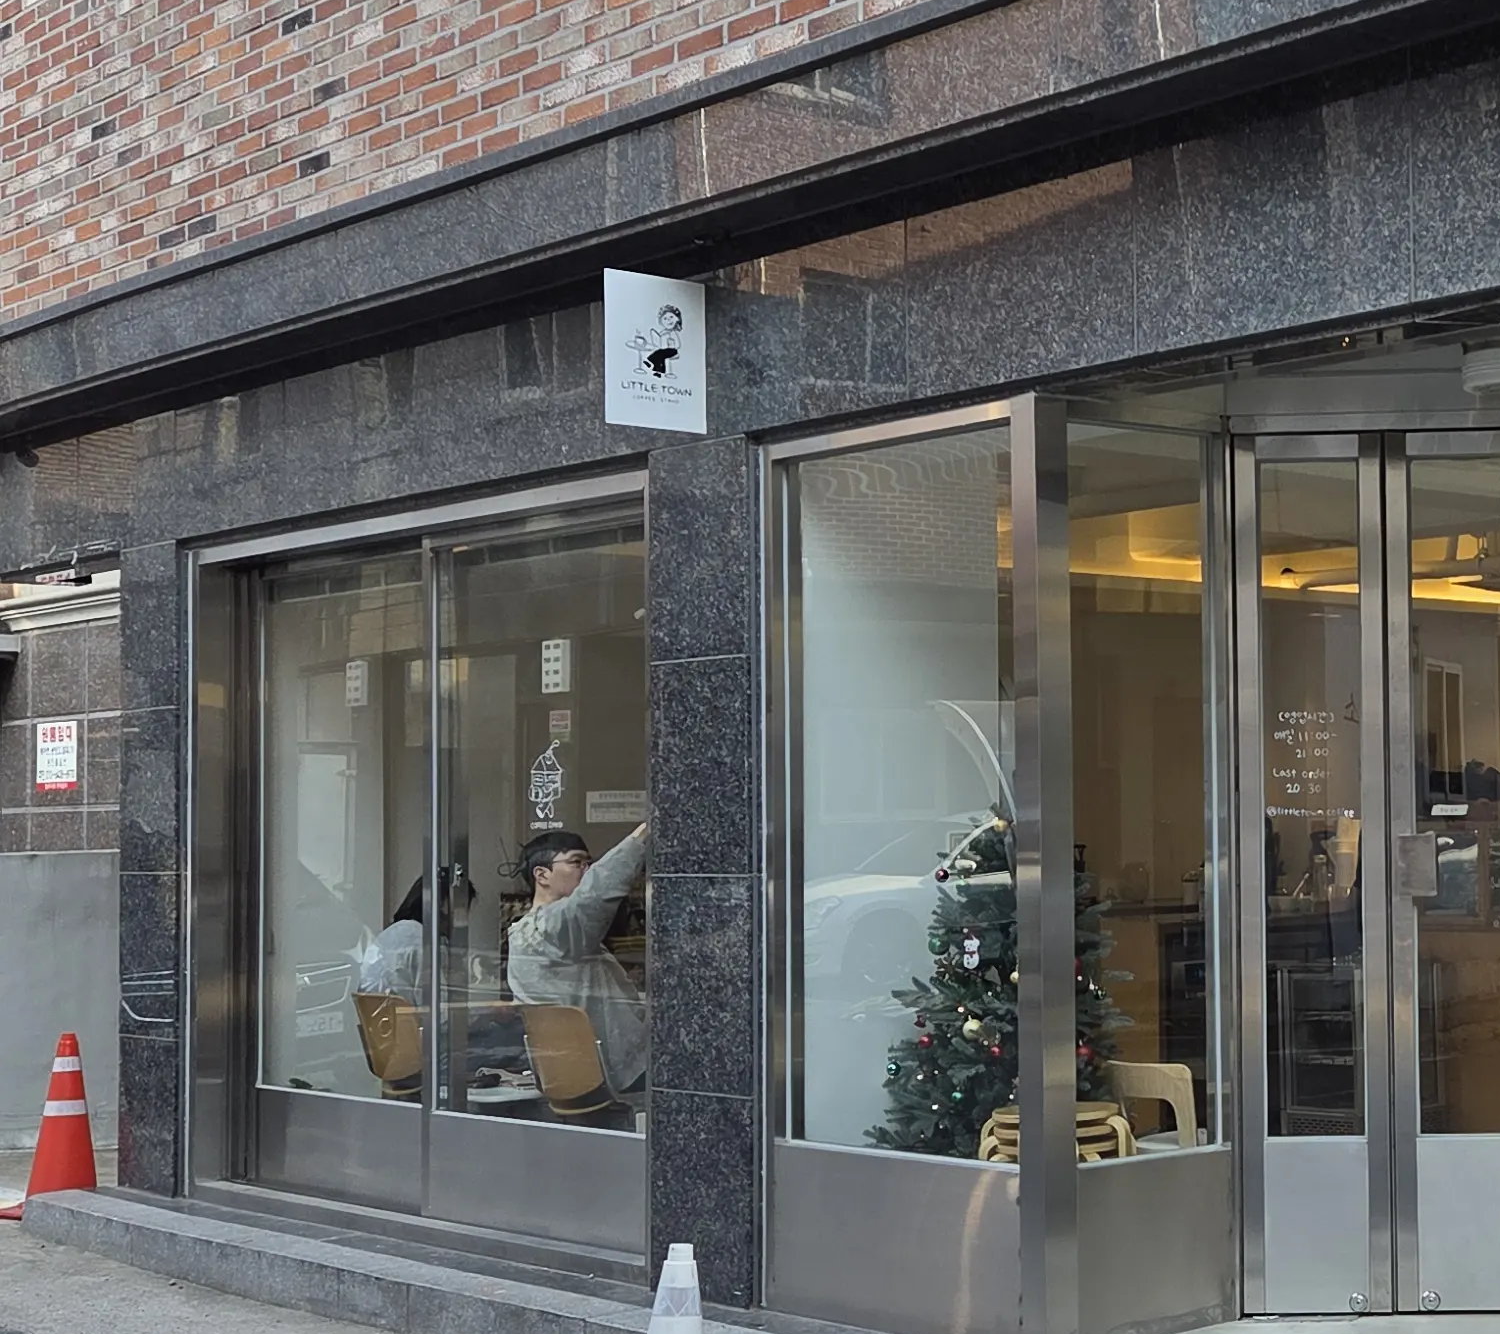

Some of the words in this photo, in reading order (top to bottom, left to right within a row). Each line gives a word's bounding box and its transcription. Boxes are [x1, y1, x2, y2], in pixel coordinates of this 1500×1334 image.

[621, 380, 658, 394] LITTLE
[660, 385, 692, 397] TOWN
[1272, 768, 1297, 779] Last
